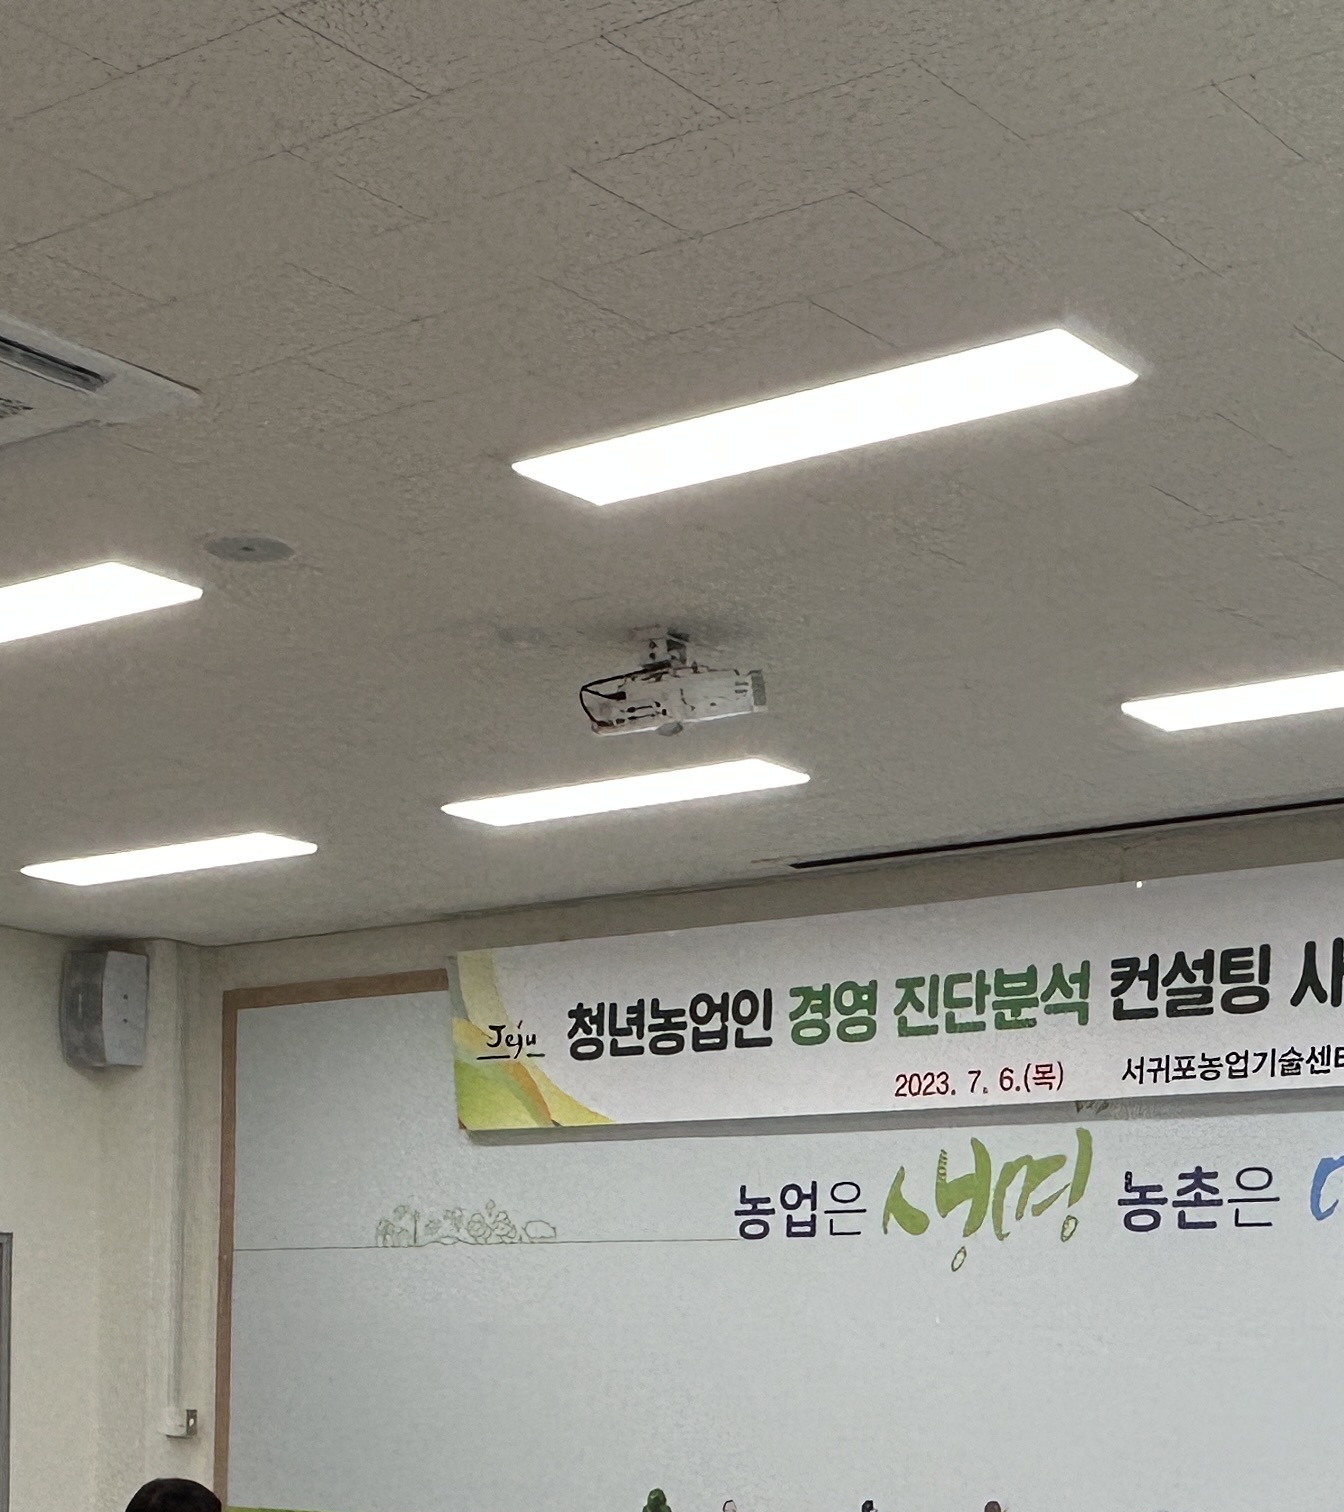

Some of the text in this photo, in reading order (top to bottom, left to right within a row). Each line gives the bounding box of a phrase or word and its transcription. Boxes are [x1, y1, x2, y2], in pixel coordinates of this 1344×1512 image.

[486, 1019, 536, 1059] Jeju
[567, 987, 773, 1061] 청년농업인
[788, 979, 878, 1046] 경영
[893, 959, 1091, 1038] 진단분석
[1110, 943, 1272, 1021] 컨설팅
[894, 1061, 1064, 1098] 2023. 7. 6.(목)
[734, 1180, 867, 1240] 농업은
[882, 1127, 1093, 1272] 생명
[1117, 1165, 1281, 1233] 농촌은
